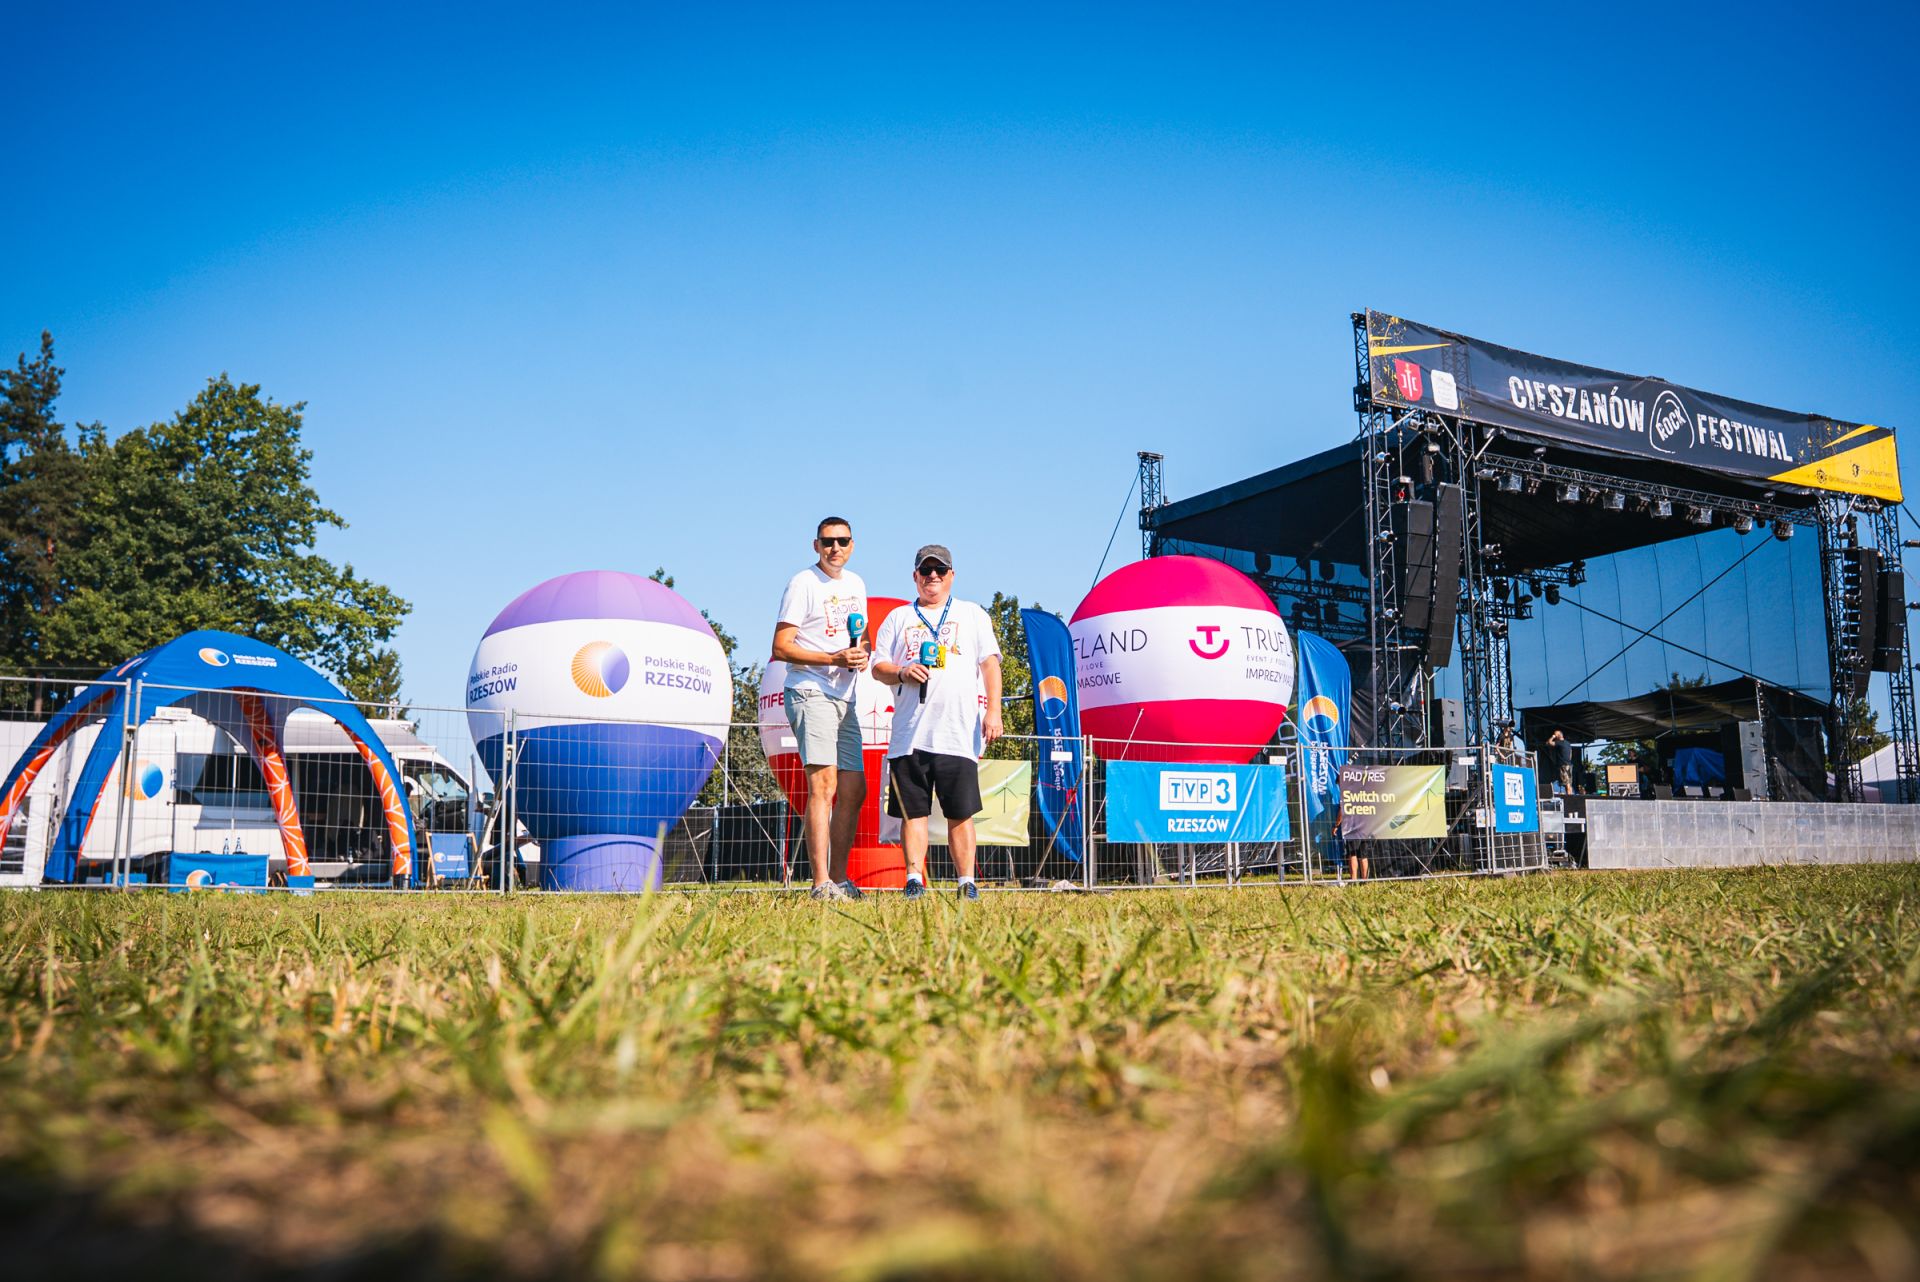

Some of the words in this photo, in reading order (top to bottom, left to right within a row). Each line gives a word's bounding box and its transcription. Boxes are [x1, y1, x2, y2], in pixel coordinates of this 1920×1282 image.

[1509, 376, 1644, 432] CIESZANÓW
[1656, 407, 1687, 441] ROCK
[1697, 413, 1793, 462] FESTIWAL
[913, 627, 950, 638] RAO
[491, 662, 518, 677] Radio
[645, 656, 685, 670] Polskie
[688, 662, 711, 677] Radio
[1086, 662, 1103, 671] LOVE
[645, 671, 712, 694] RZESZÓW
[1246, 668, 1283, 683] IMPREZY
[470, 676, 517, 704] RZESZÓW
[1170, 782, 1209, 799] TVP
[1343, 791, 1379, 803] Switch
[1381, 793, 1396, 803] on
[1343, 803, 1376, 815] Green
[1167, 815, 1229, 832] RZESZÓW
